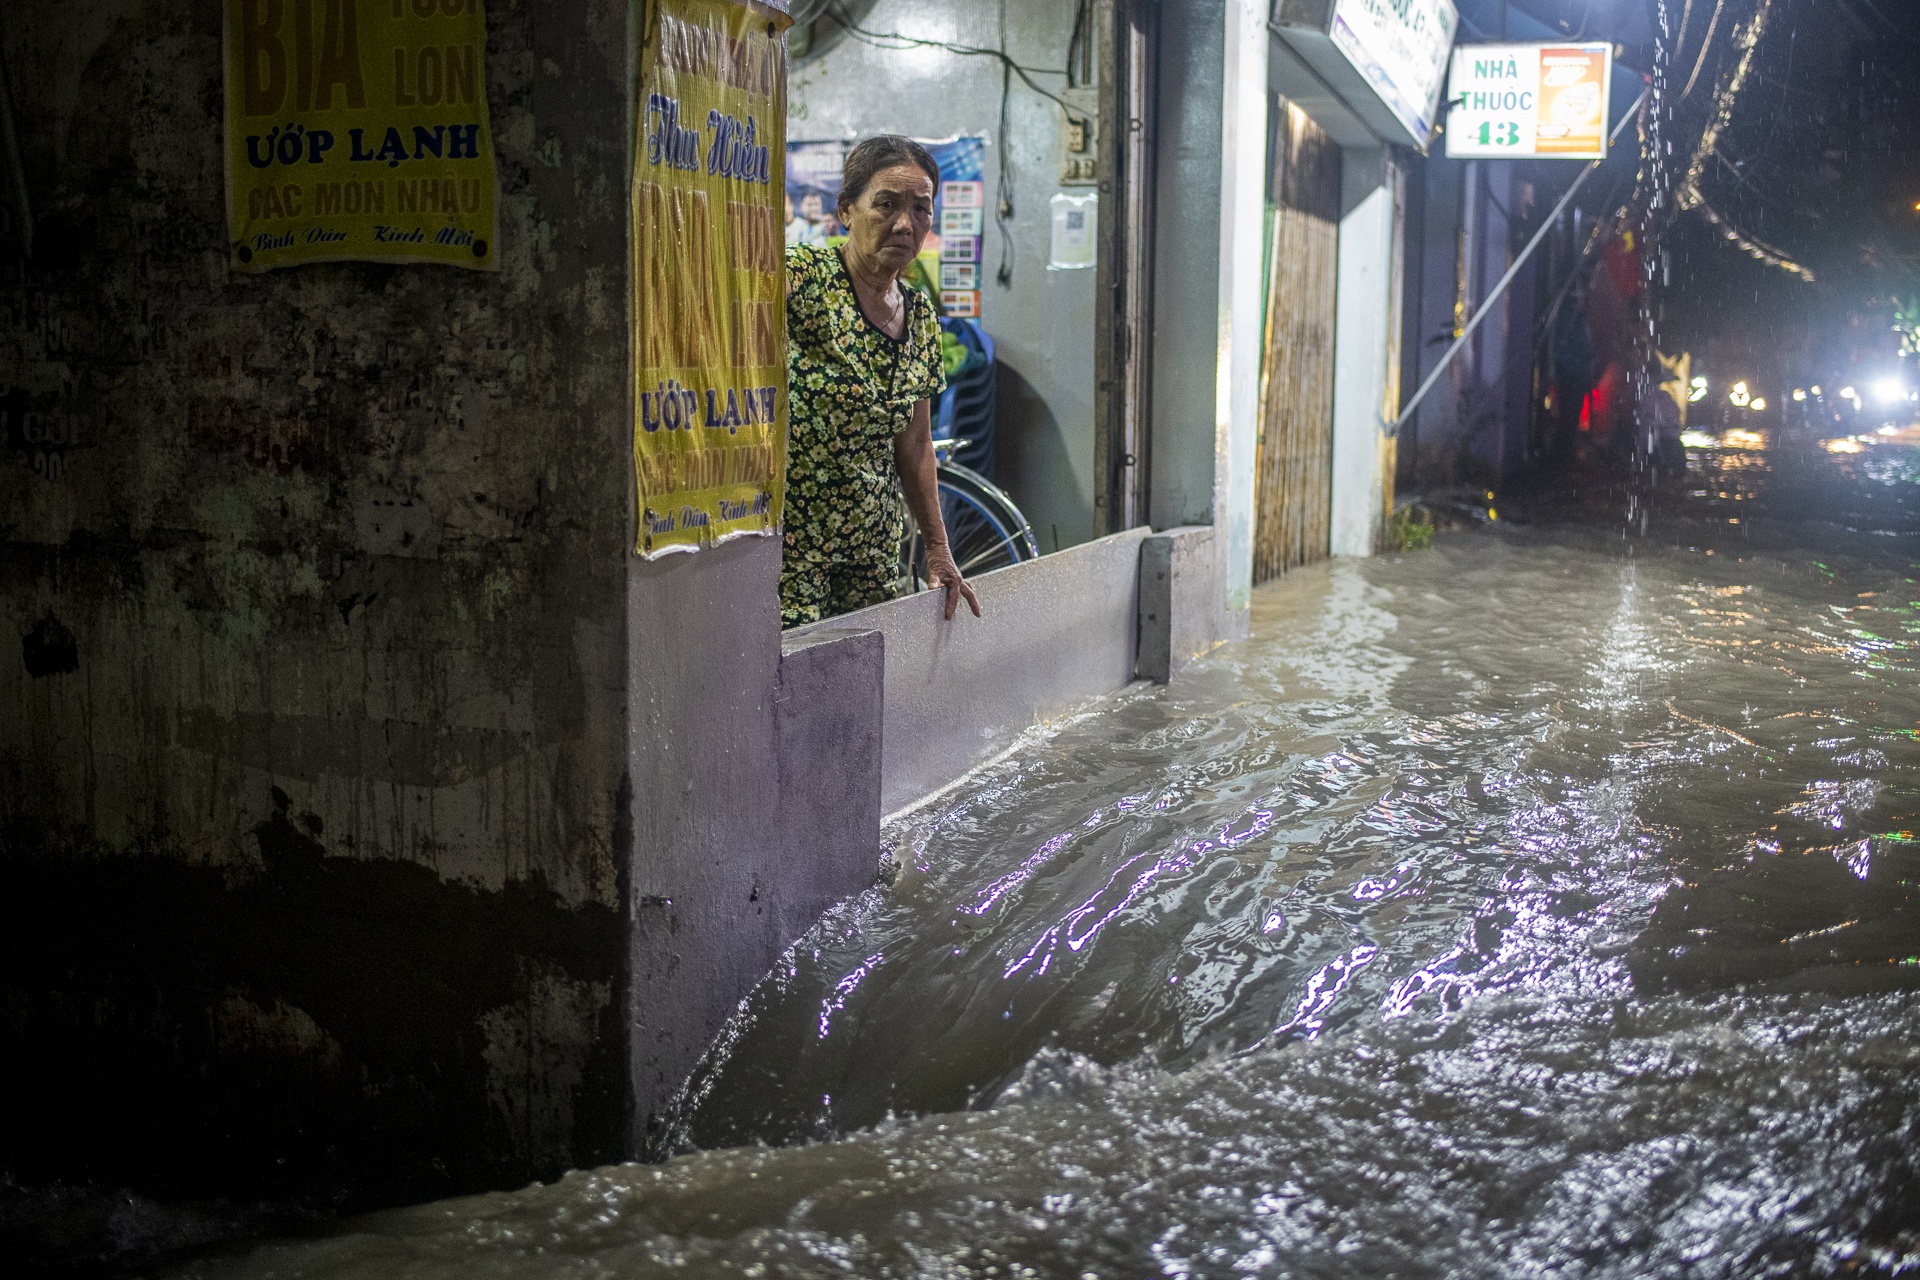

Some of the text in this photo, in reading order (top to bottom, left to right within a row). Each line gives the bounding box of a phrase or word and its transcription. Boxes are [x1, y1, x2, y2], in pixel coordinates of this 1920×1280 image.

[242, 0, 367, 117] BIA
[393, 45, 475, 107] LON
[1474, 53, 1518, 79] NHÀ
[245, 122, 480, 169] ƯỚP LẠNH
[644, 93, 700, 173] Thu
[1468, 121, 1521, 147] 43
[641, 379, 777, 436] ƯỚP LẠNH
